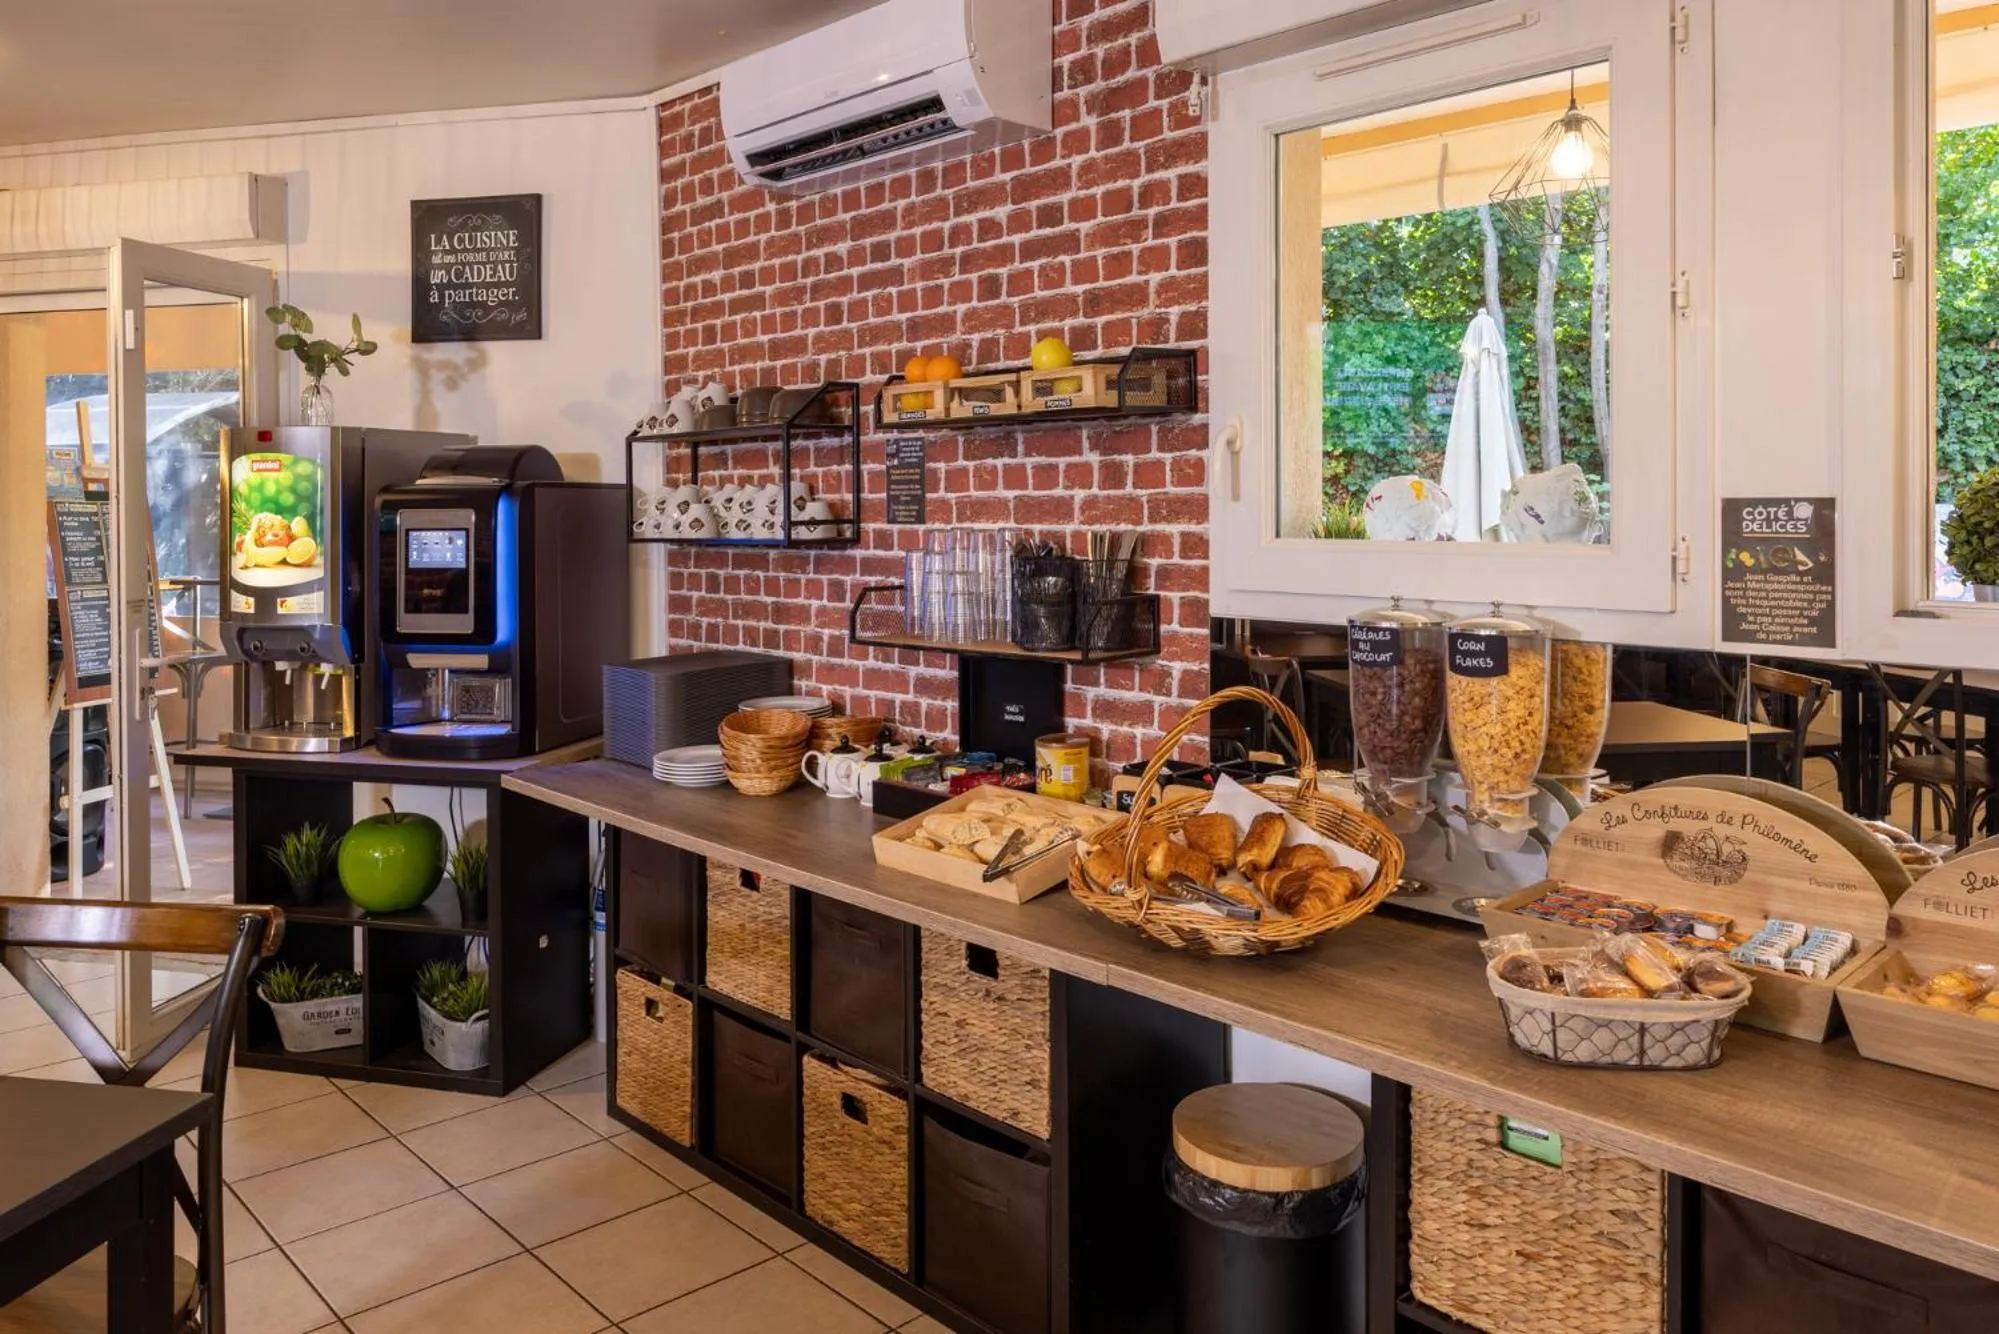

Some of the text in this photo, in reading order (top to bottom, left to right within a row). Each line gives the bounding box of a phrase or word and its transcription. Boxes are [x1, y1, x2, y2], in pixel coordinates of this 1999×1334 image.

[430, 230, 518, 250] LA CUISINE
[457, 252, 488, 262] FORME
[430, 263, 517, 284] un CADEAU
[429, 285, 519, 307] à partager.
[1742, 504, 1789, 520] CÔTÉ
[1802, 574, 1812, 582] et
[1358, 641, 1371, 651] AU
[1457, 638, 1486, 651] CORN
[1352, 651, 1393, 662] CHOCOLAT
[1456, 655, 1494, 668] FLAKES
[1600, 802, 1819, 863] Les Confitures de Philomène
[1960, 871, 1999, 894] Les
